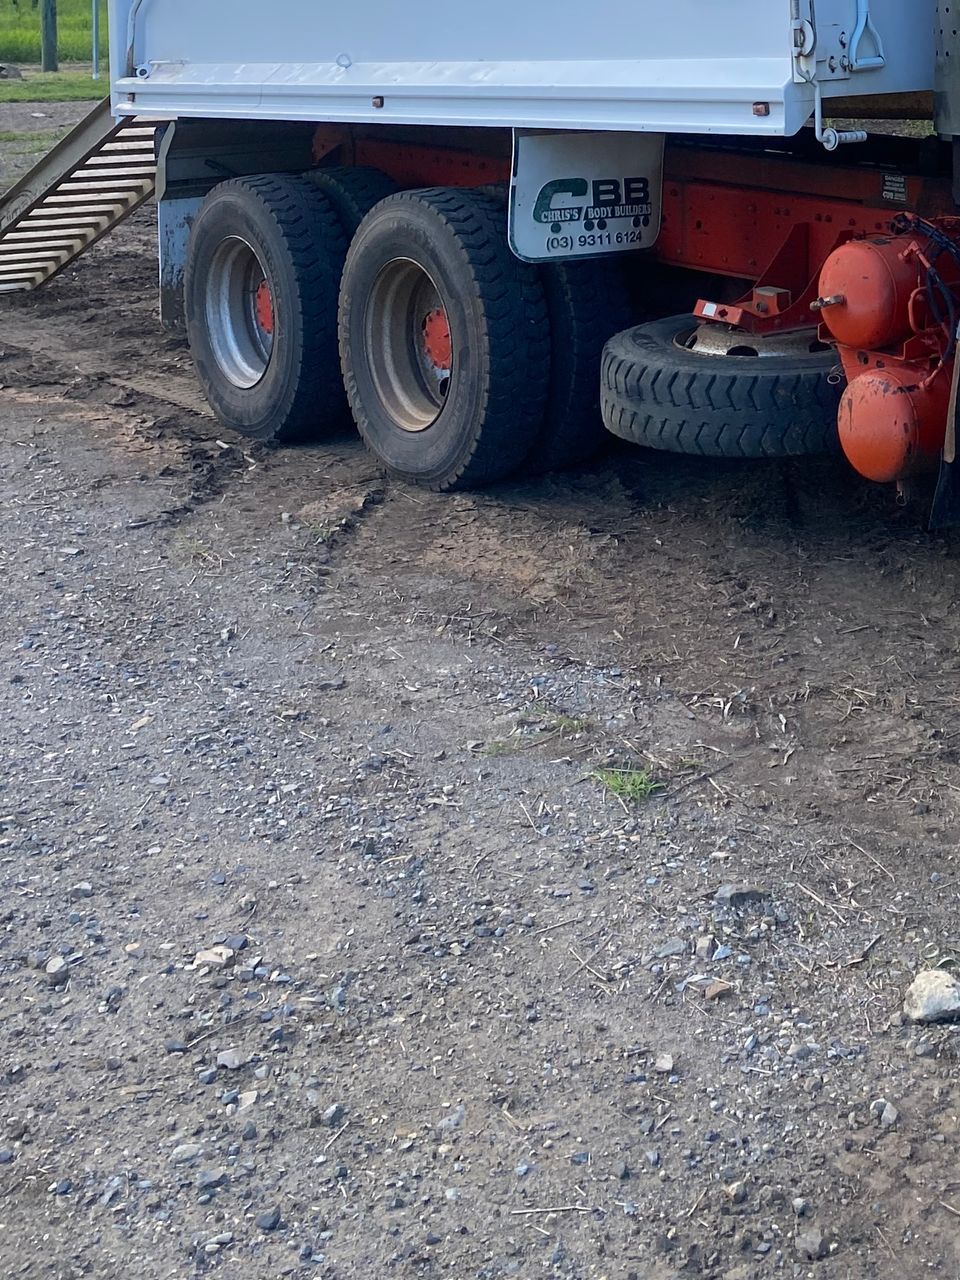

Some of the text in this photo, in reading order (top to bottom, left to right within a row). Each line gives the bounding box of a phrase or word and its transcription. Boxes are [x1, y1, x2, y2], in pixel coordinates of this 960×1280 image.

[533, 177, 650, 222] CBB
[541, 203, 652, 222] CHRIS'S BODY BUILDERS
[546, 230, 642, 252] (03) 9311 6124
